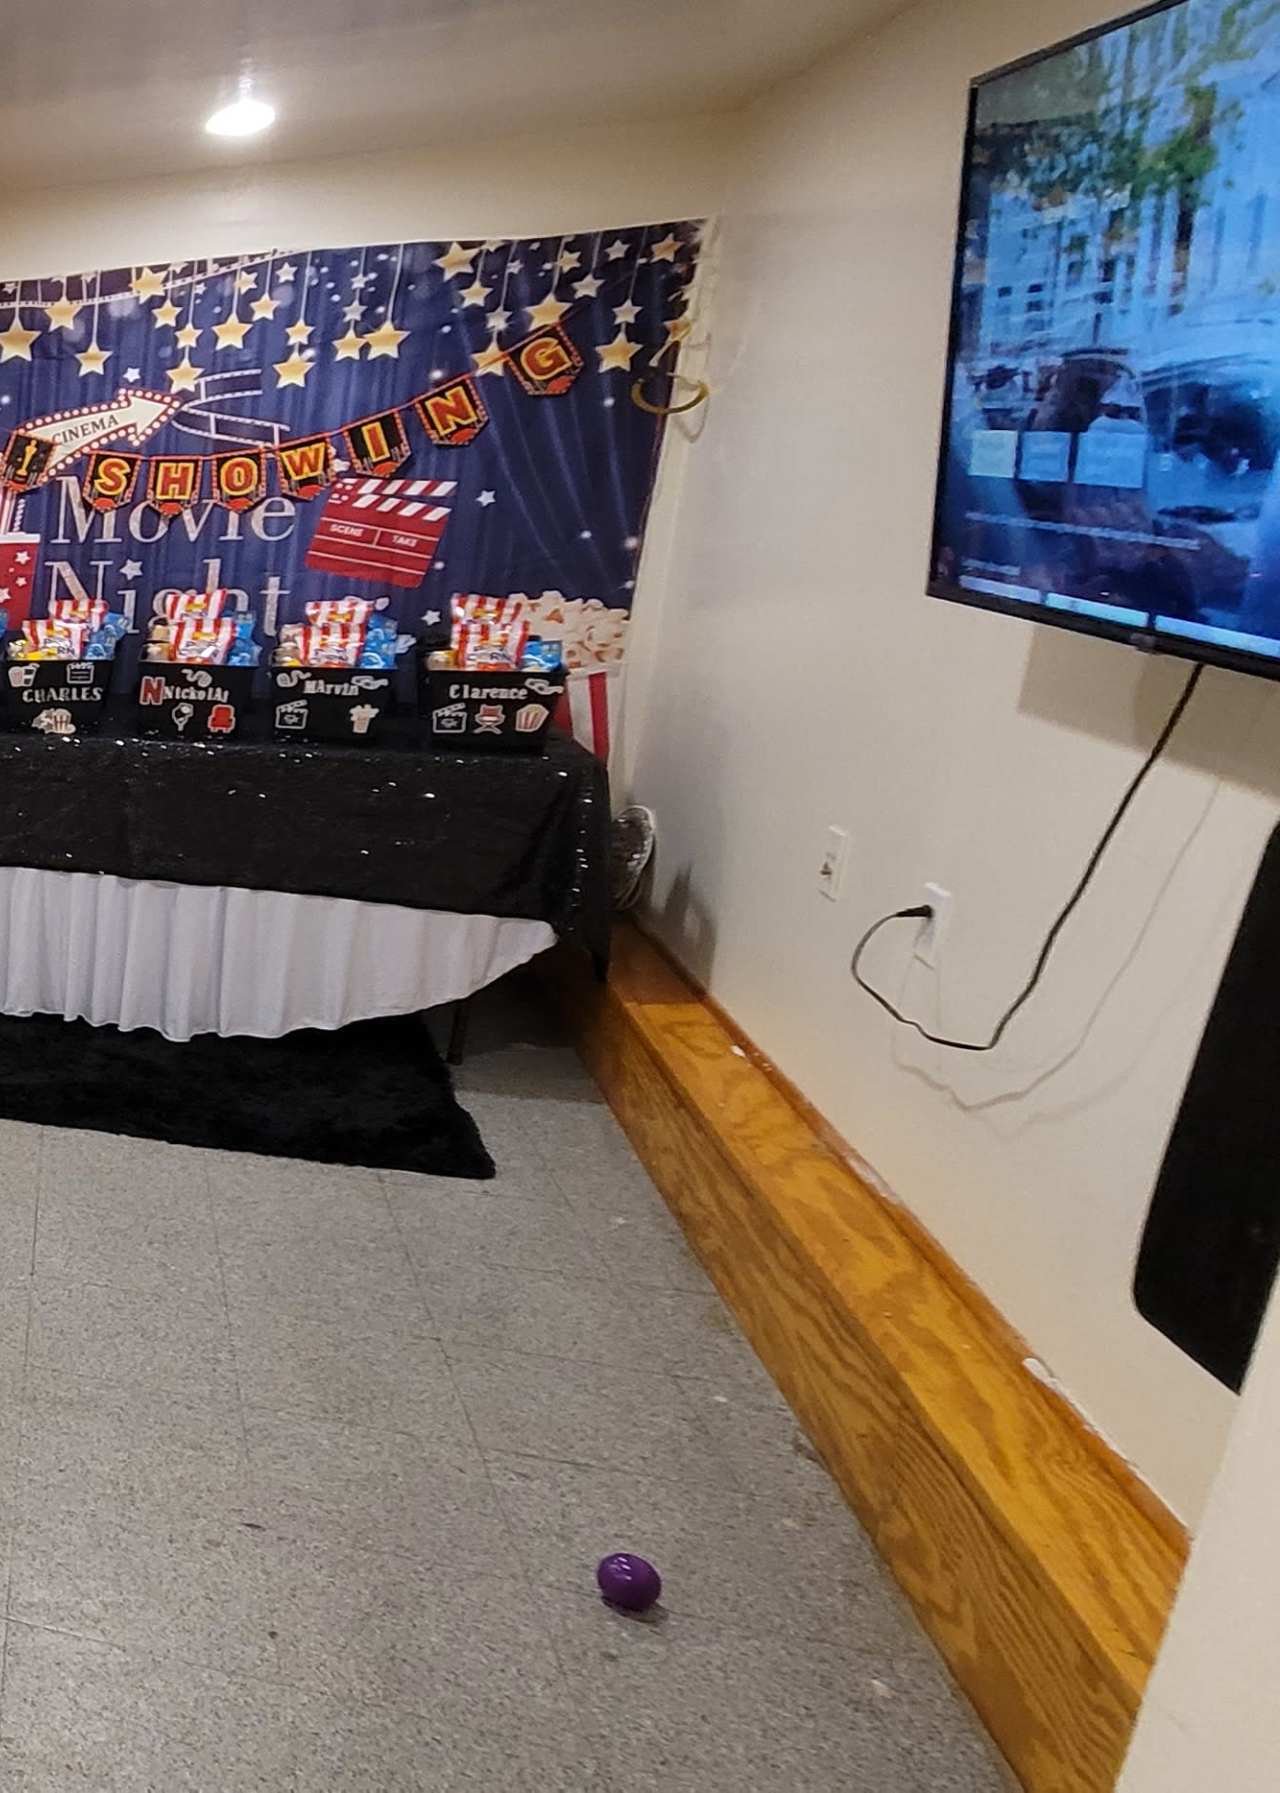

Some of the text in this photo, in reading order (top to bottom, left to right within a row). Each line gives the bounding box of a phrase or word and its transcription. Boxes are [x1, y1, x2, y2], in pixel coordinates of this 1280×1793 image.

[94, 336, 574, 500] SHOWING
[52, 414, 119, 445] CINEMA
[329, 523, 364, 538] SCENE
[391, 534, 418, 548] TAKE
[22, 686, 104, 702] CHARLES
[448, 684, 529, 700] Clarence
